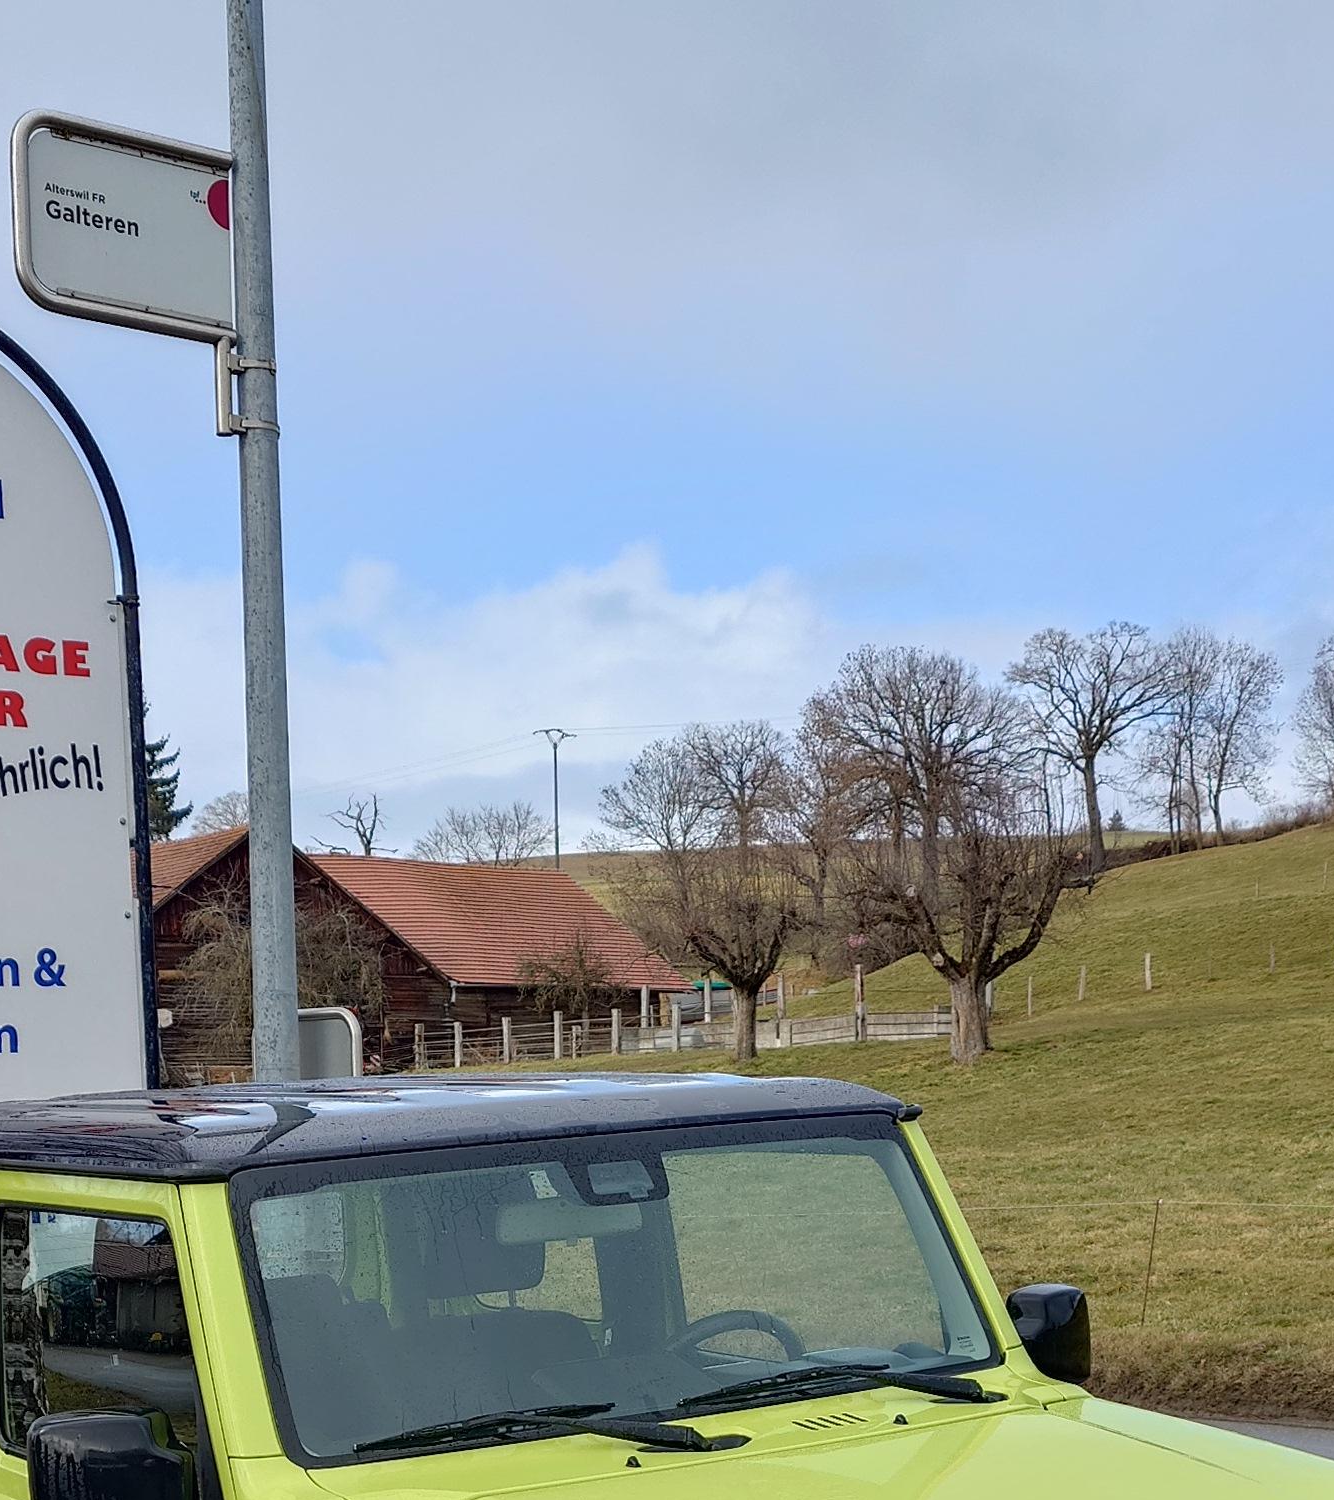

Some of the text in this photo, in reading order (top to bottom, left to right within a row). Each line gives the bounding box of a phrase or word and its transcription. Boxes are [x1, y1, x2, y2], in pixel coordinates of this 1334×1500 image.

[44, 182, 106, 204] Alterswil FR
[45, 200, 140, 237] Galteren
[33, 948, 67, 988] &
